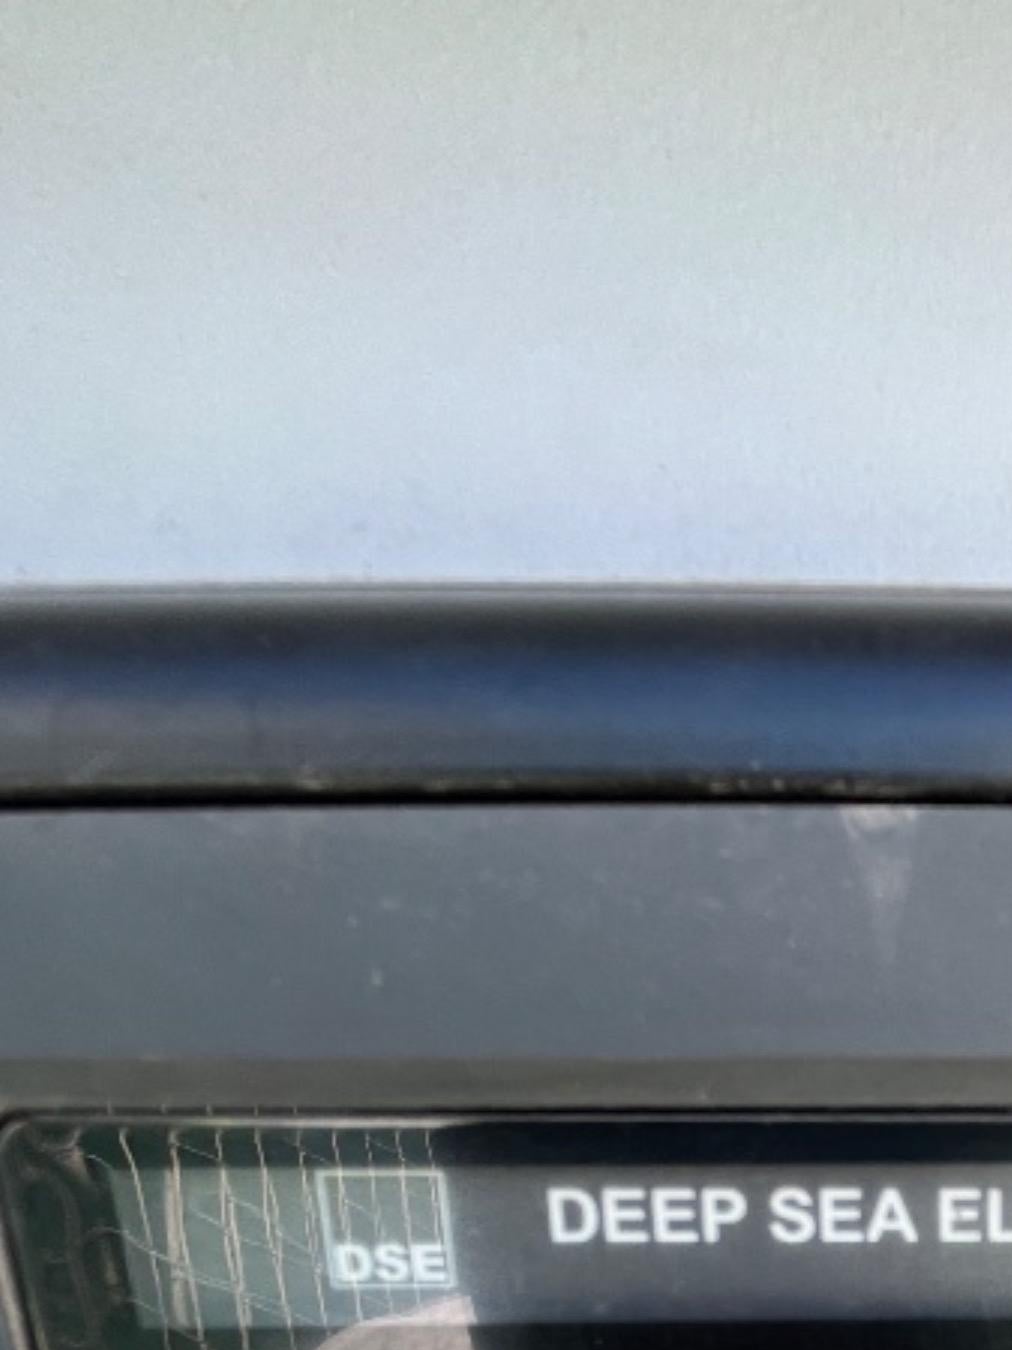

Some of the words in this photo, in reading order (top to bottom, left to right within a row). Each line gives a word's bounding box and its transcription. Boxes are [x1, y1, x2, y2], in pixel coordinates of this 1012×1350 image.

[546, 1187, 748, 1243] DEEP
[768, 1187, 919, 1243] SEA
[333, 1243, 447, 1282] DSE
